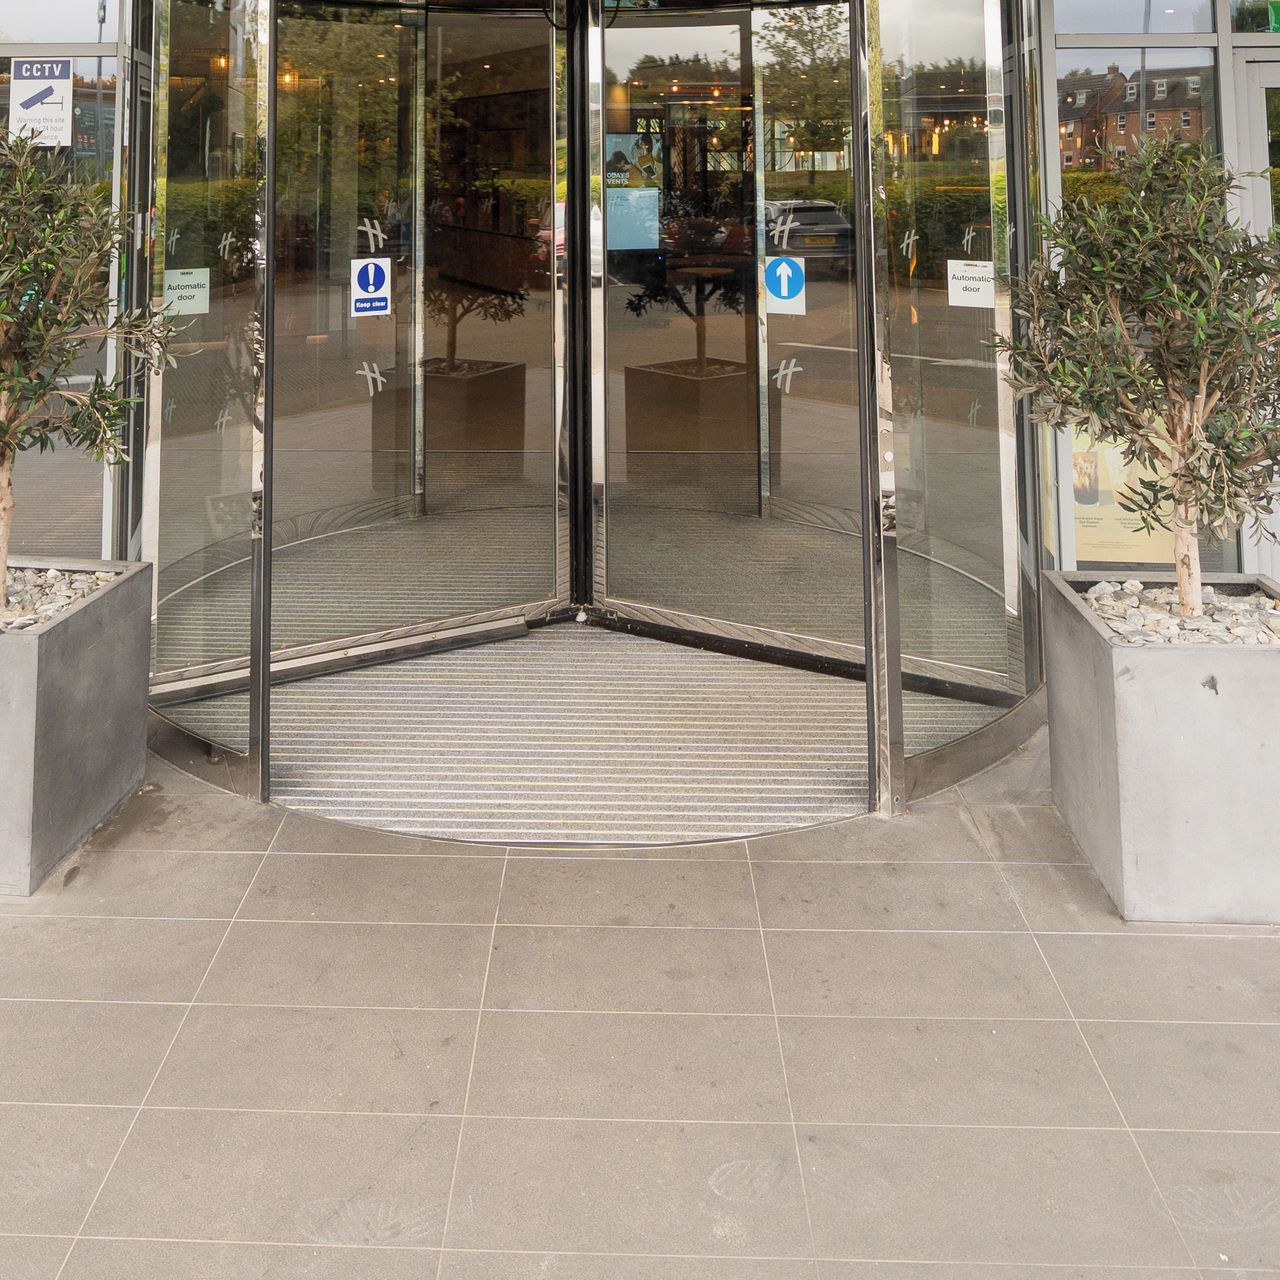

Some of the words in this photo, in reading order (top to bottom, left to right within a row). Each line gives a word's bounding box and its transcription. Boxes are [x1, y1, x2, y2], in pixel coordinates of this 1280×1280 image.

[22, 64, 62, 76] CCTV
[951, 274, 992, 283] Automatic
[167, 282, 206, 291] Automatic
[962, 285, 981, 293] door
